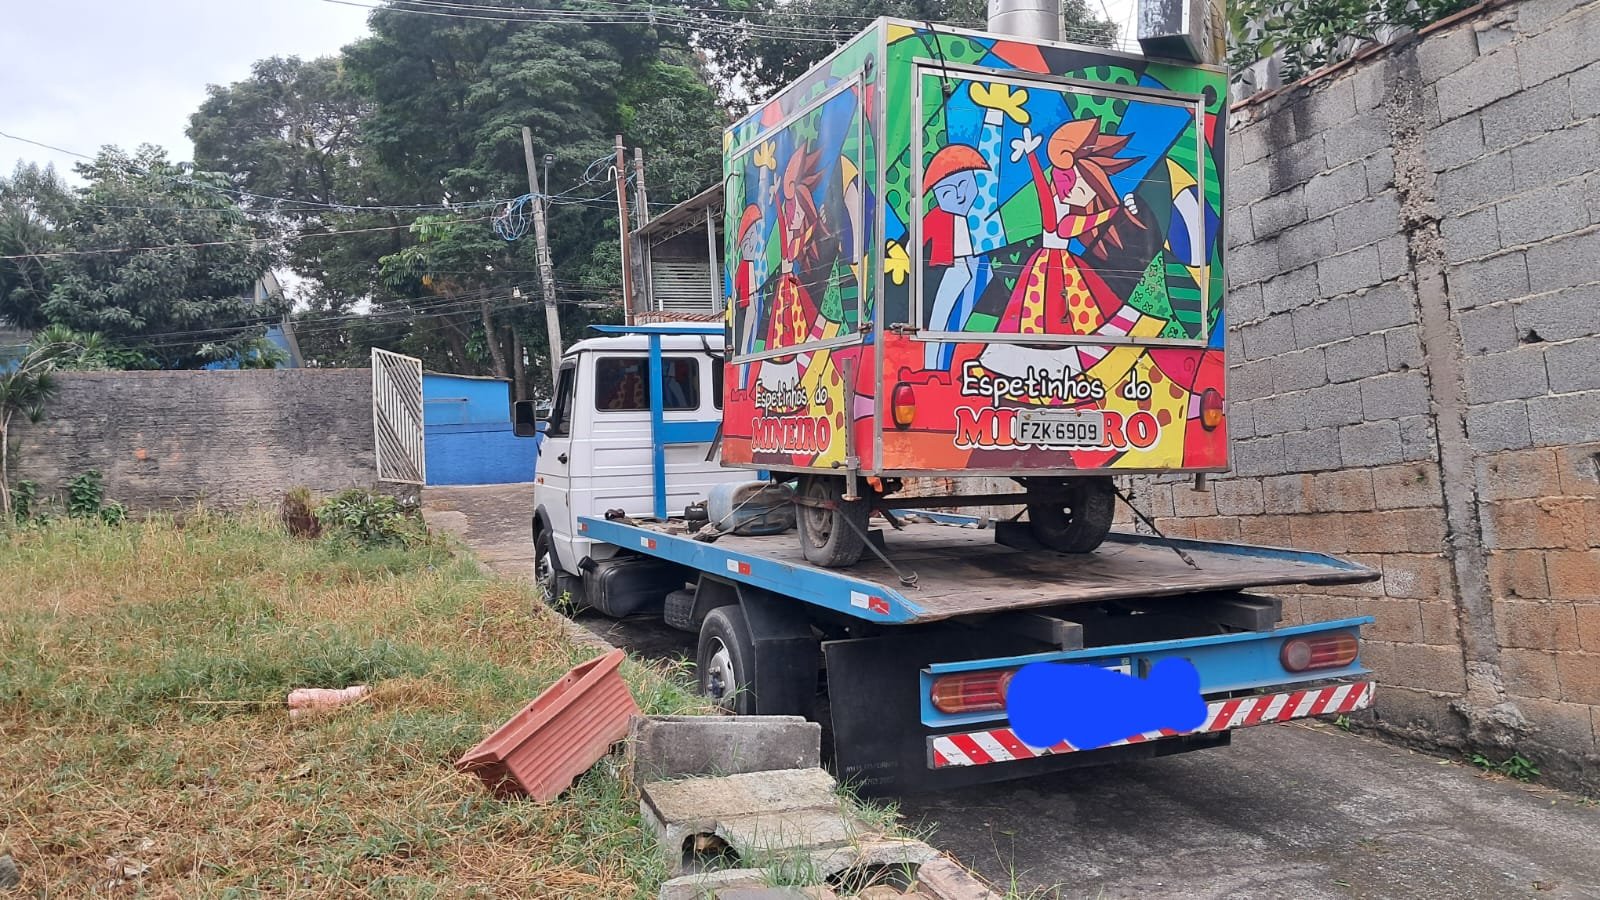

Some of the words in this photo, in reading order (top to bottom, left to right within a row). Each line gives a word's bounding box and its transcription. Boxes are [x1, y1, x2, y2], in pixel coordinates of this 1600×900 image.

[755, 379, 808, 417] Espetinhos
[814, 375, 829, 405] do
[962, 360, 1105, 407] Espetinhos
[1123, 367, 1152, 400] do
[752, 415, 832, 455] MINEIRO
[955, 407, 1161, 450] MIRO
